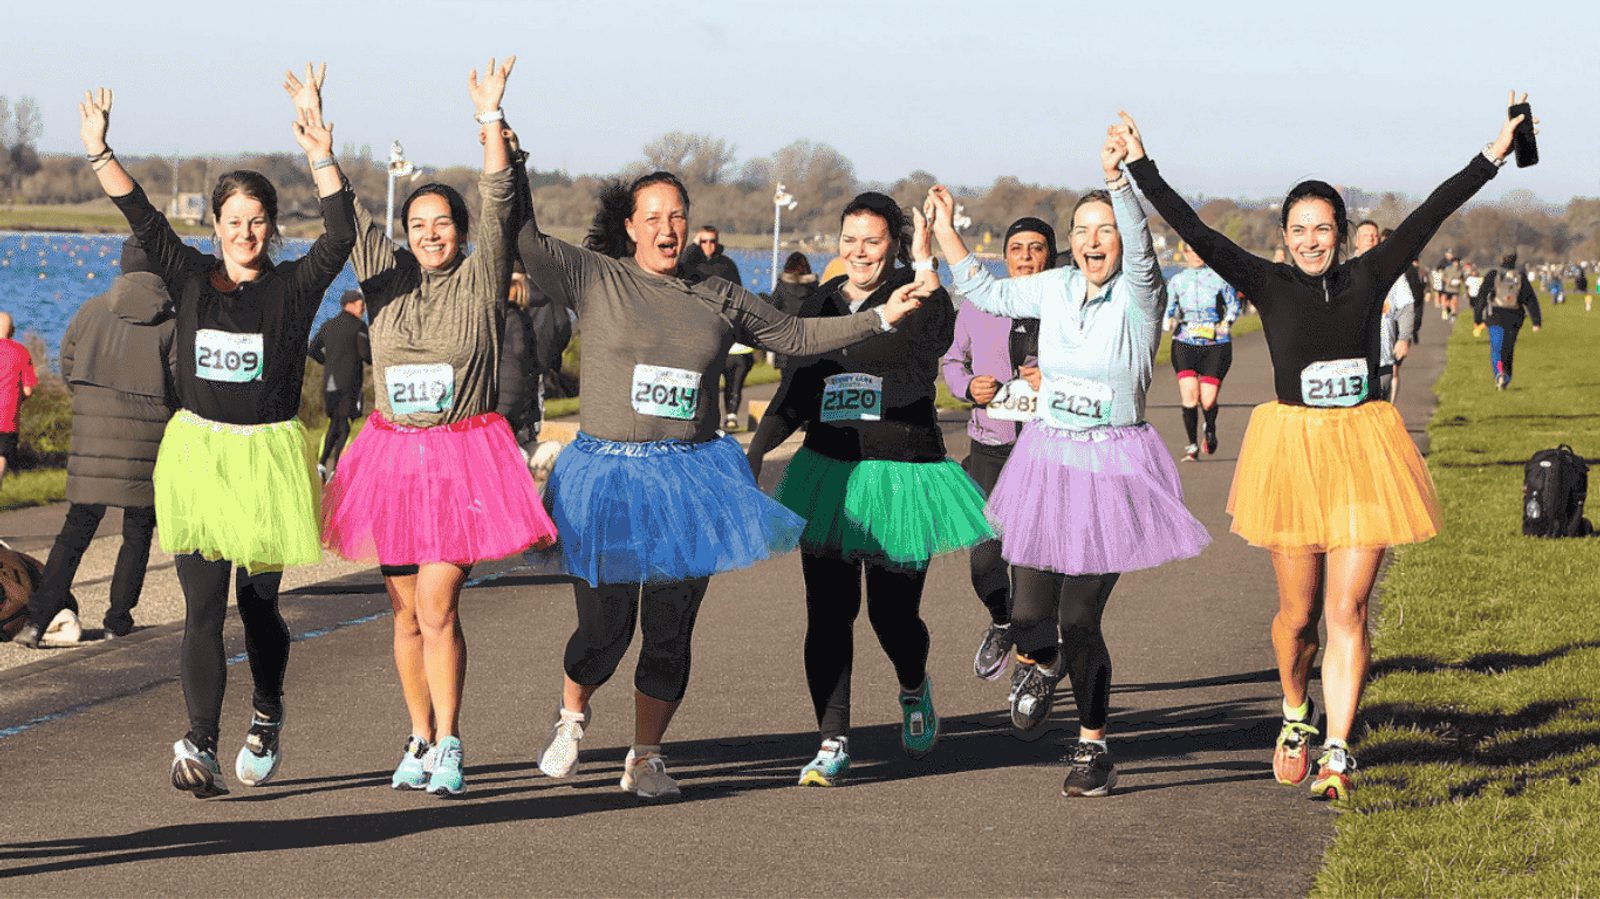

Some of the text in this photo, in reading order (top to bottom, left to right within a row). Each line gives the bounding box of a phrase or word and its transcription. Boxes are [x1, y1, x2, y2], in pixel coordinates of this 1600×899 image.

[198, 346, 258, 372] 2109
[635, 381, 695, 409] 2014
[823, 389, 876, 410] 2120
[1308, 375, 1364, 399] 2113
[1051, 390, 1103, 419] 2121
